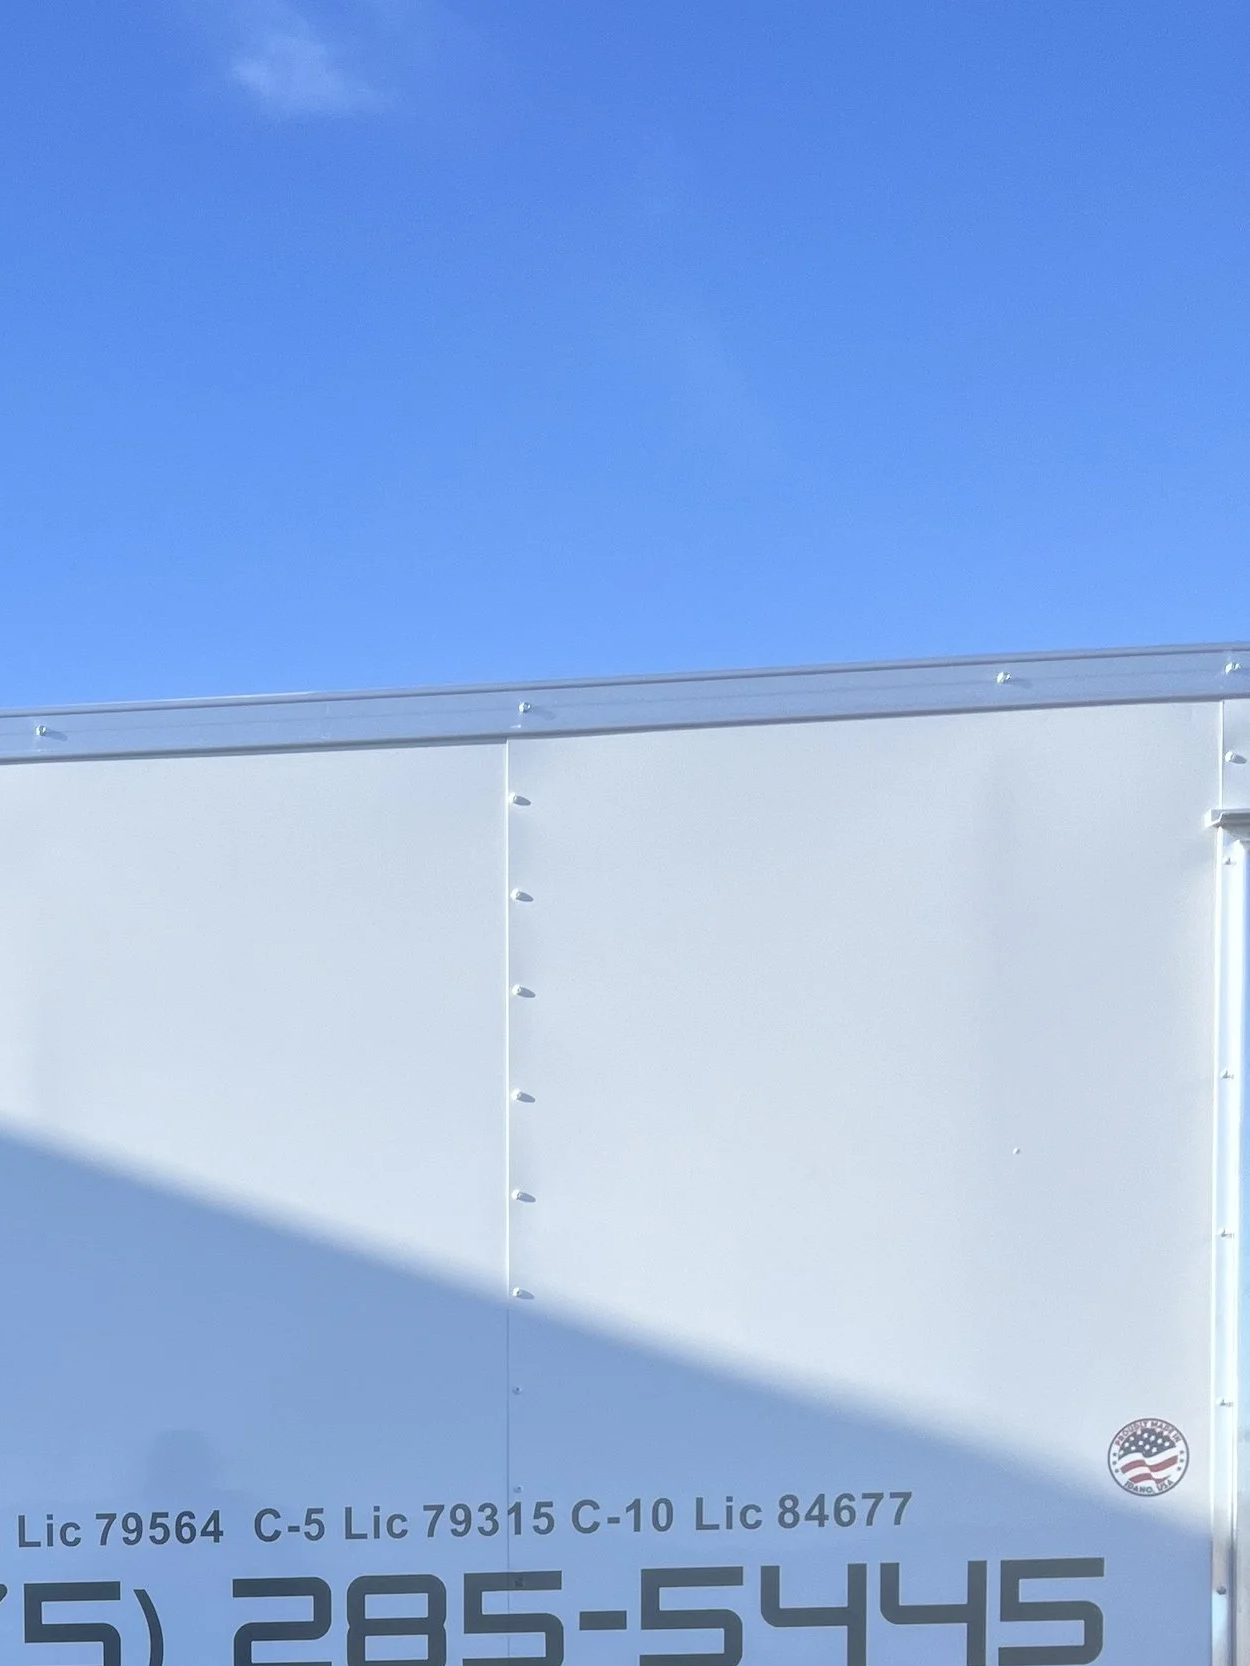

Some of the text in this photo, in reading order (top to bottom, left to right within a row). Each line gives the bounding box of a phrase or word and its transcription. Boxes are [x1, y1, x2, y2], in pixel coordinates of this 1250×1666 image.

[1115, 1421, 1181, 1446] PROUDLY MADE IN
[1157, 1480, 1174, 1491] USA
[18, 1513, 82, 1548] Lic
[95, 1509, 224, 1546] 79564
[254, 1507, 325, 1543] C-5
[344, 1505, 409, 1540] Lic
[422, 1501, 555, 1538] 79315
[571, 1497, 674, 1534] C-10
[695, 1496, 762, 1531] Lic
[777, 1491, 912, 1529] 84677
